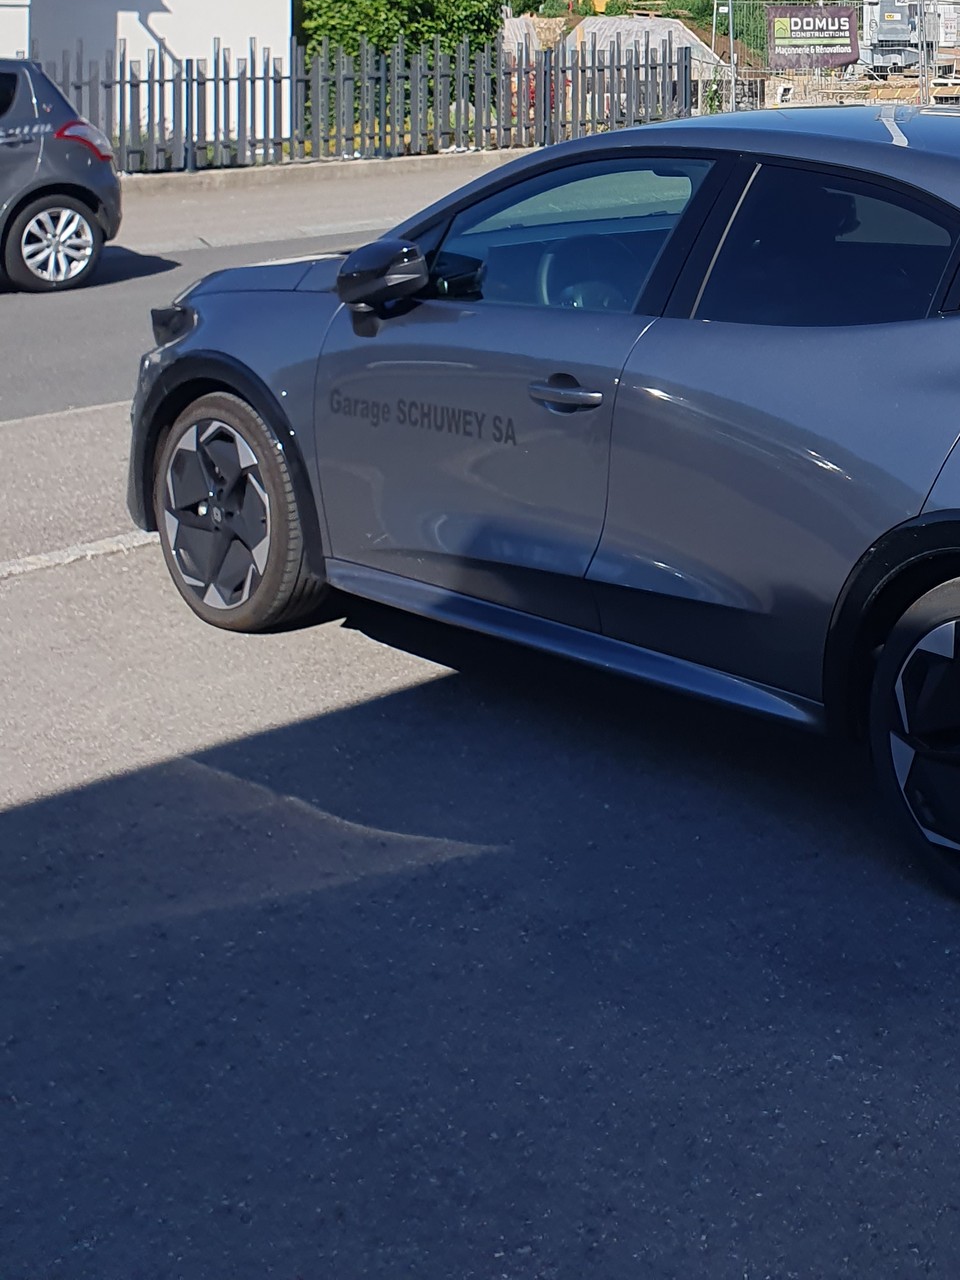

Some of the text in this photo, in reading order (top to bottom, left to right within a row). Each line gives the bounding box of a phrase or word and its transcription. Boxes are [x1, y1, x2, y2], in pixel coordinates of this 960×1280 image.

[791, 17, 849, 30] DOMUS
[775, 45, 809, 56] Maçonnerie
[816, 45, 852, 53] Rénovations
[330, 389, 516, 446] Garage SCHUWEY SA
